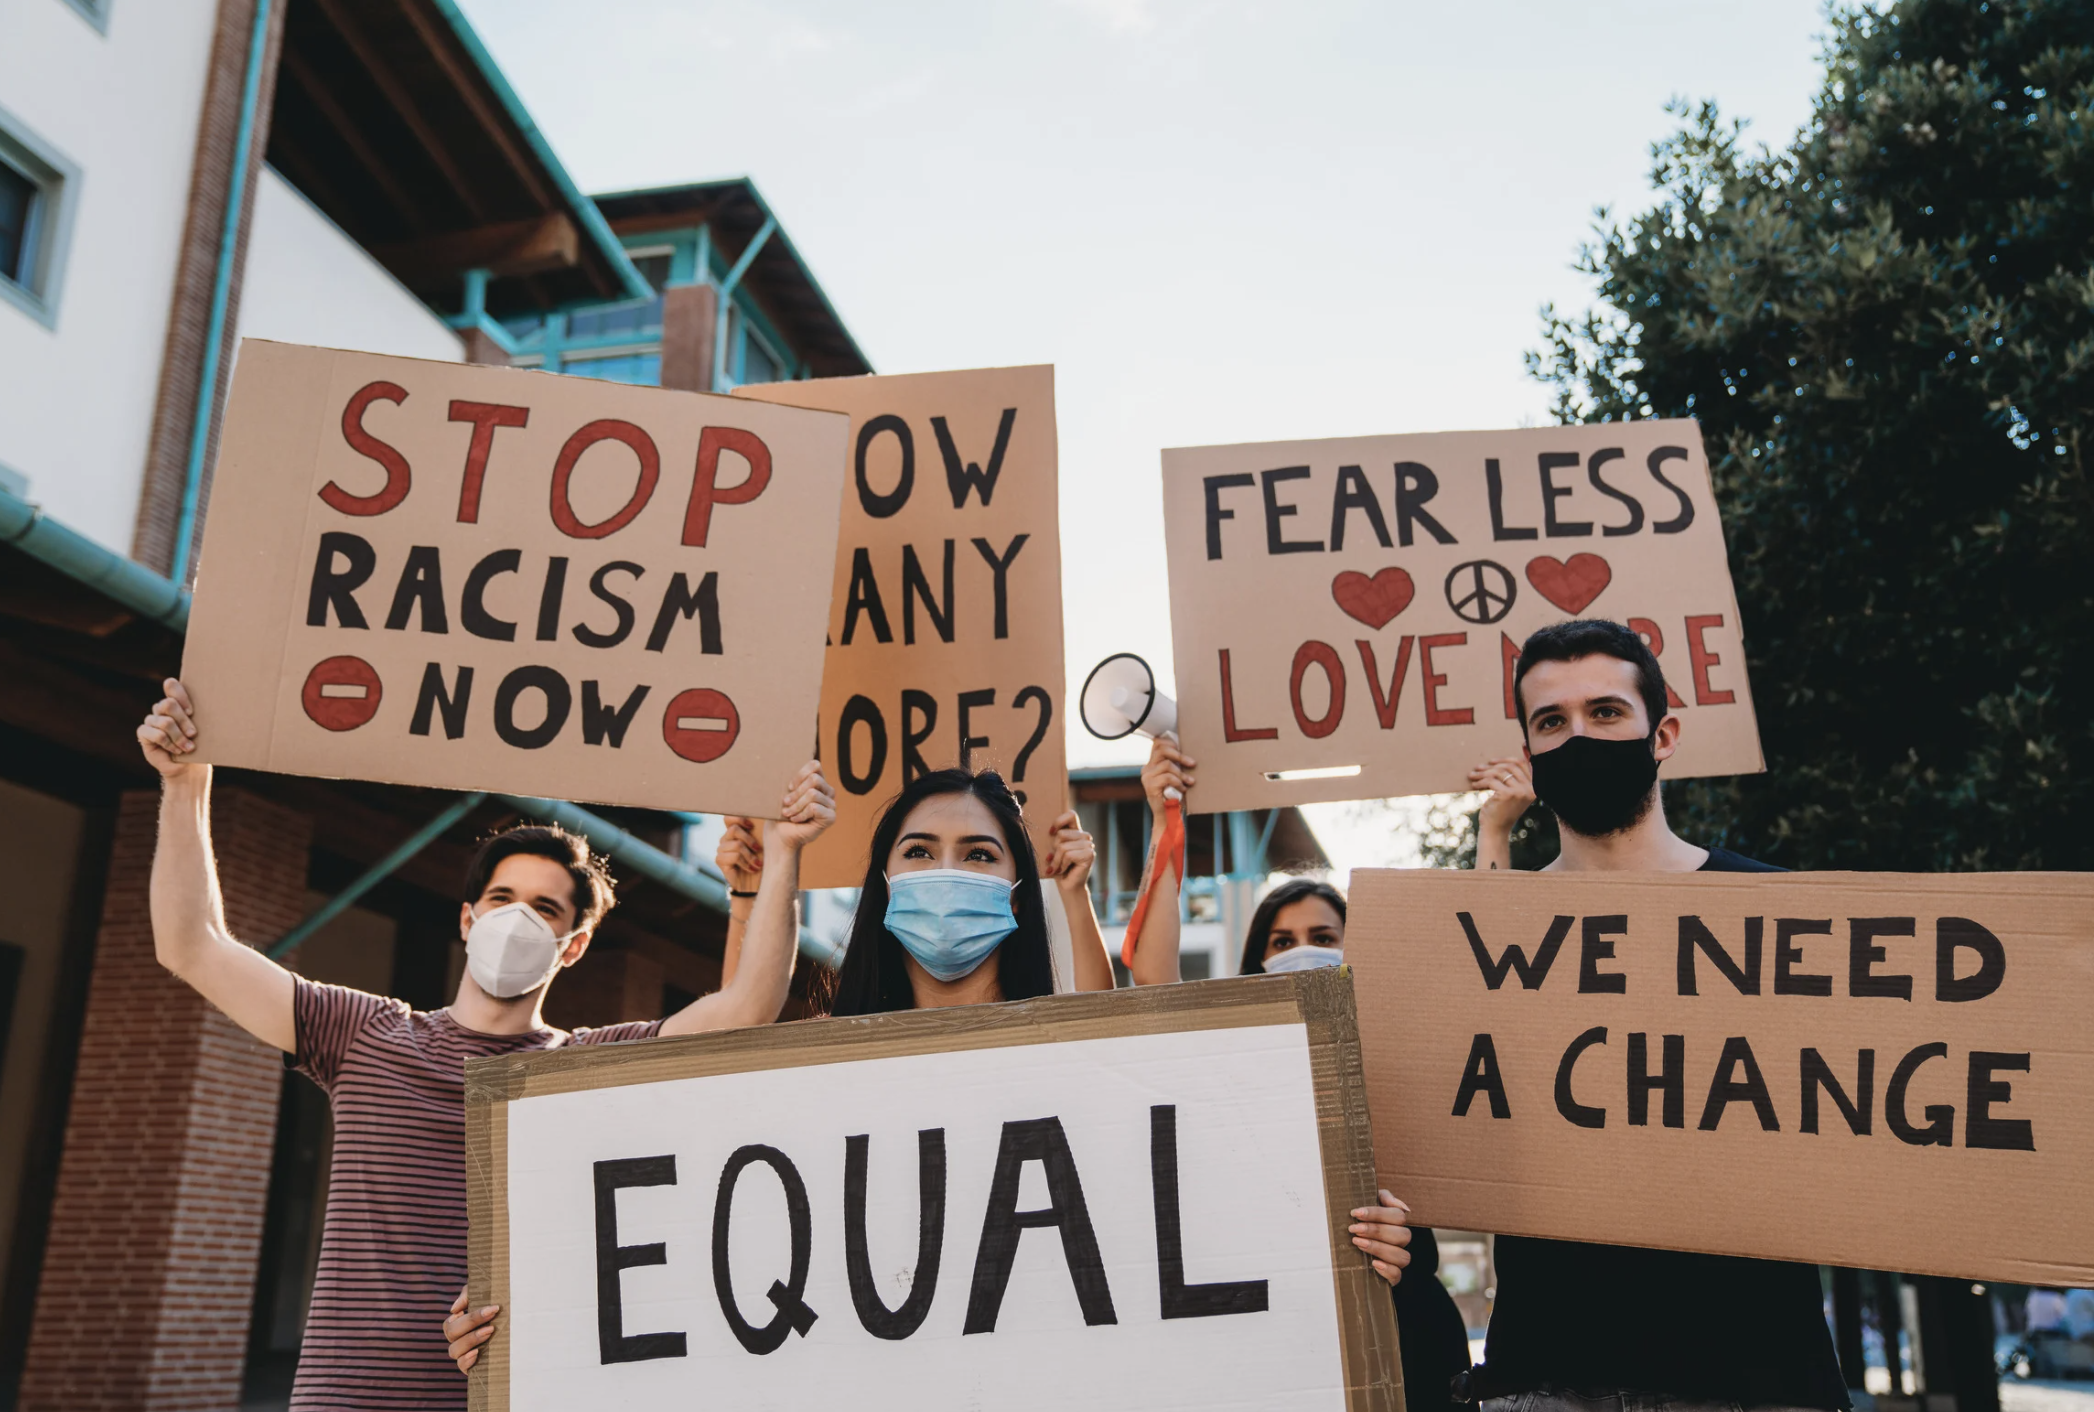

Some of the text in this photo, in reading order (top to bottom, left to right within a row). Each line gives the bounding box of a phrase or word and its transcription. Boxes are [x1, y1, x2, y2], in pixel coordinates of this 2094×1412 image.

[318, 380, 772, 548] STOP
[854, 407, 1017, 519] OW
[1203, 445, 1696, 561] FEAR LESS
[306, 531, 723, 655] RACISM
[826, 533, 1031, 646] ANY
[408, 662, 652, 750] NOW
[1218, 614, 1736, 743] LOVE RE
[814, 685, 1054, 806] ORE?
[1455, 911, 2007, 1003] WE NEED
[1451, 1025, 2037, 1152] A CHANGE
[593, 1104, 1269, 1366] EQUAL
